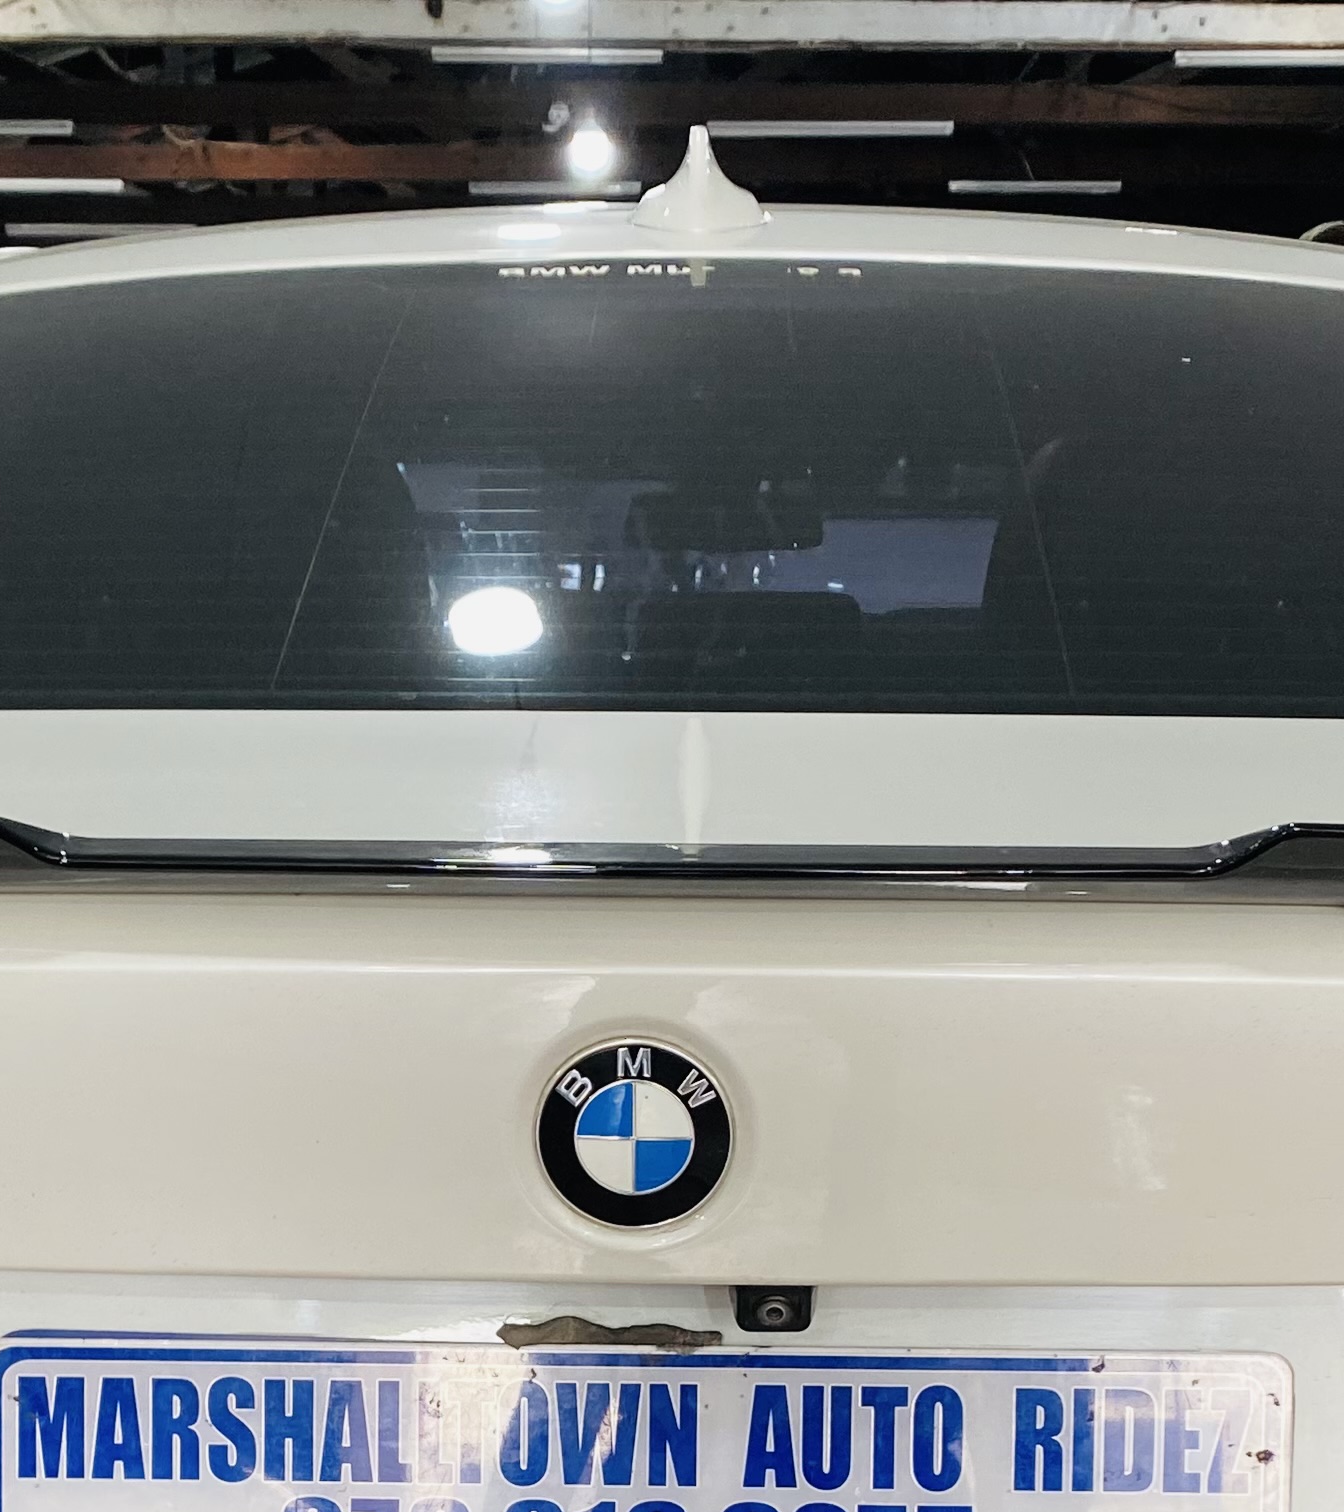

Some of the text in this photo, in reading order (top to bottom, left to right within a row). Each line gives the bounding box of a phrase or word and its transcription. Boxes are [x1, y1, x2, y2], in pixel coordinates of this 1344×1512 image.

[554, 1047, 717, 1108] BMW
[16, 1374, 1258, 1496] MARSHALLTOWN AUTO RIDEZ
